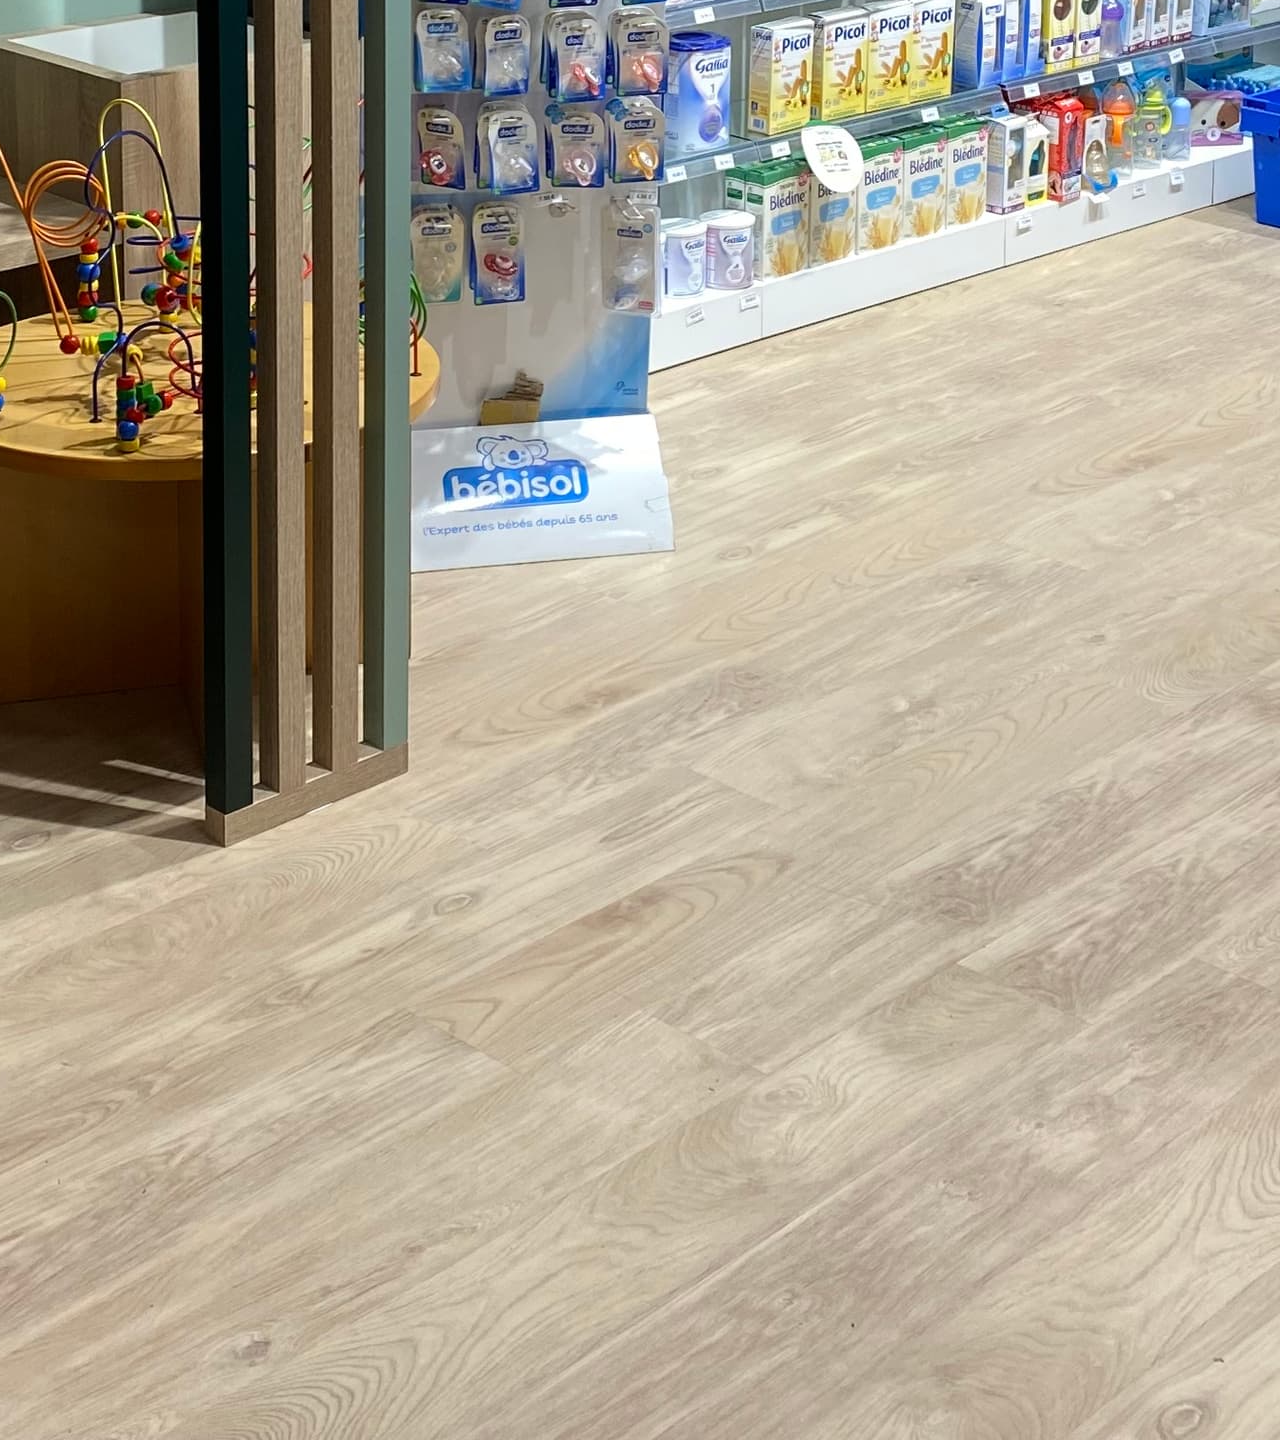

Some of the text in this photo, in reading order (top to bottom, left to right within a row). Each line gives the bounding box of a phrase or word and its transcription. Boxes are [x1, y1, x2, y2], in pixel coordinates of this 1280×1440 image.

[879, 15, 910, 33] Picot
[921, 8, 952, 26] Picot
[835, 23, 866, 42] Picot
[782, 33, 811, 54] Picot
[695, 58, 728, 73] Gallia
[953, 144, 985, 163] Blédine
[909, 156, 943, 175] Blédine
[865, 167, 899, 186] Blédine
[770, 191, 806, 211] Blédine
[451, 466, 582, 500] bébisol
[473, 523, 494, 531] des
[497, 519, 533, 531] bébés
[535, 516, 576, 528] depuis
[579, 514, 593, 523] 65
[595, 512, 618, 522] ans
